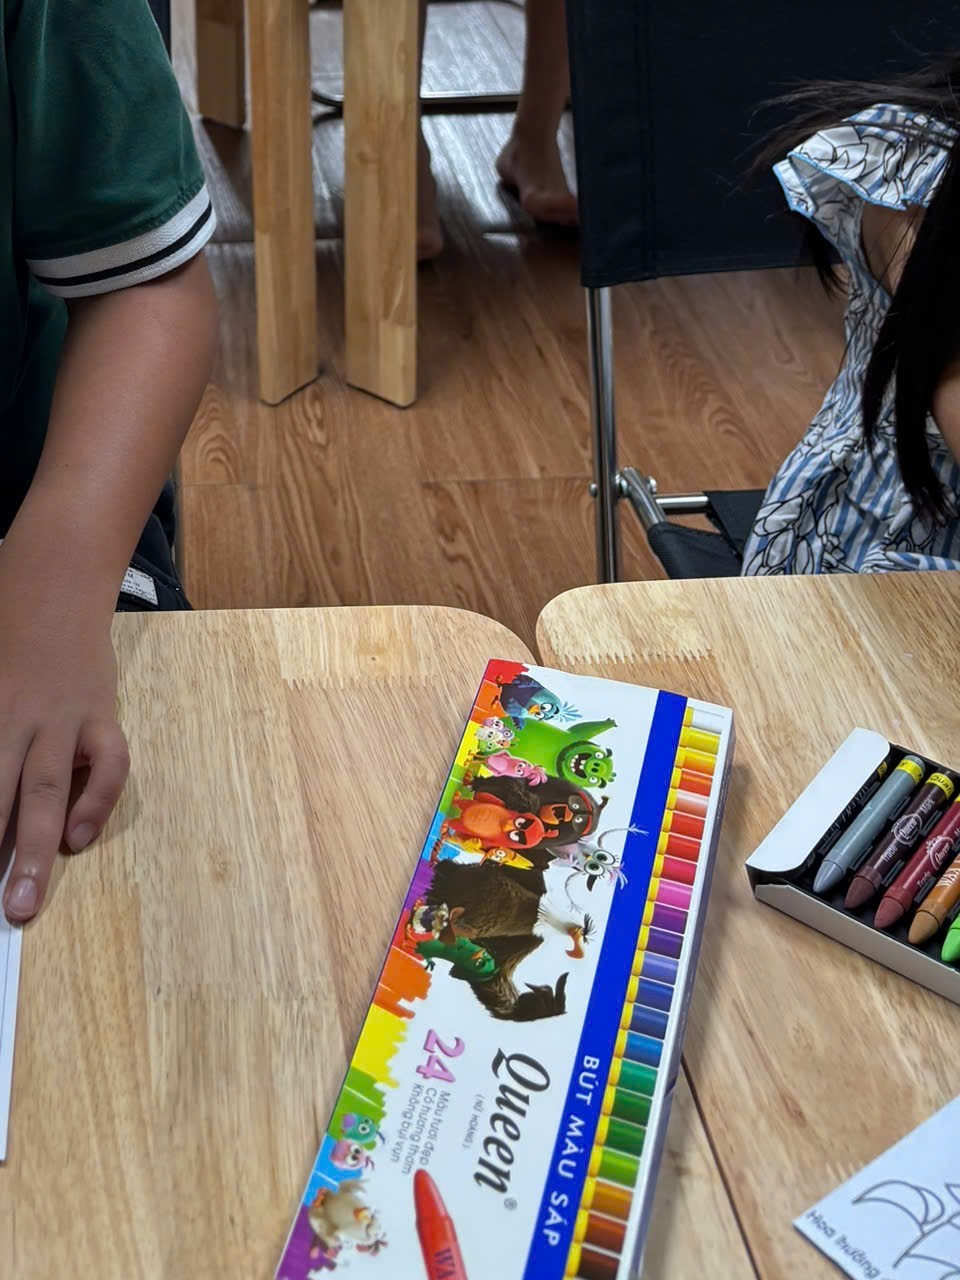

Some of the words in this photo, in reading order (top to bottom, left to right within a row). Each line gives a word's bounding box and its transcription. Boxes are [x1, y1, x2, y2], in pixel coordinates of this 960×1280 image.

[900, 818, 918, 840] Queen
[416, 1028, 465, 1083] 24
[575, 1055, 600, 1106] BÚT
[473, 1047, 551, 1194] Queen
[557, 1114, 586, 1179] MÀU
[542, 1191, 569, 1247] SÁP
